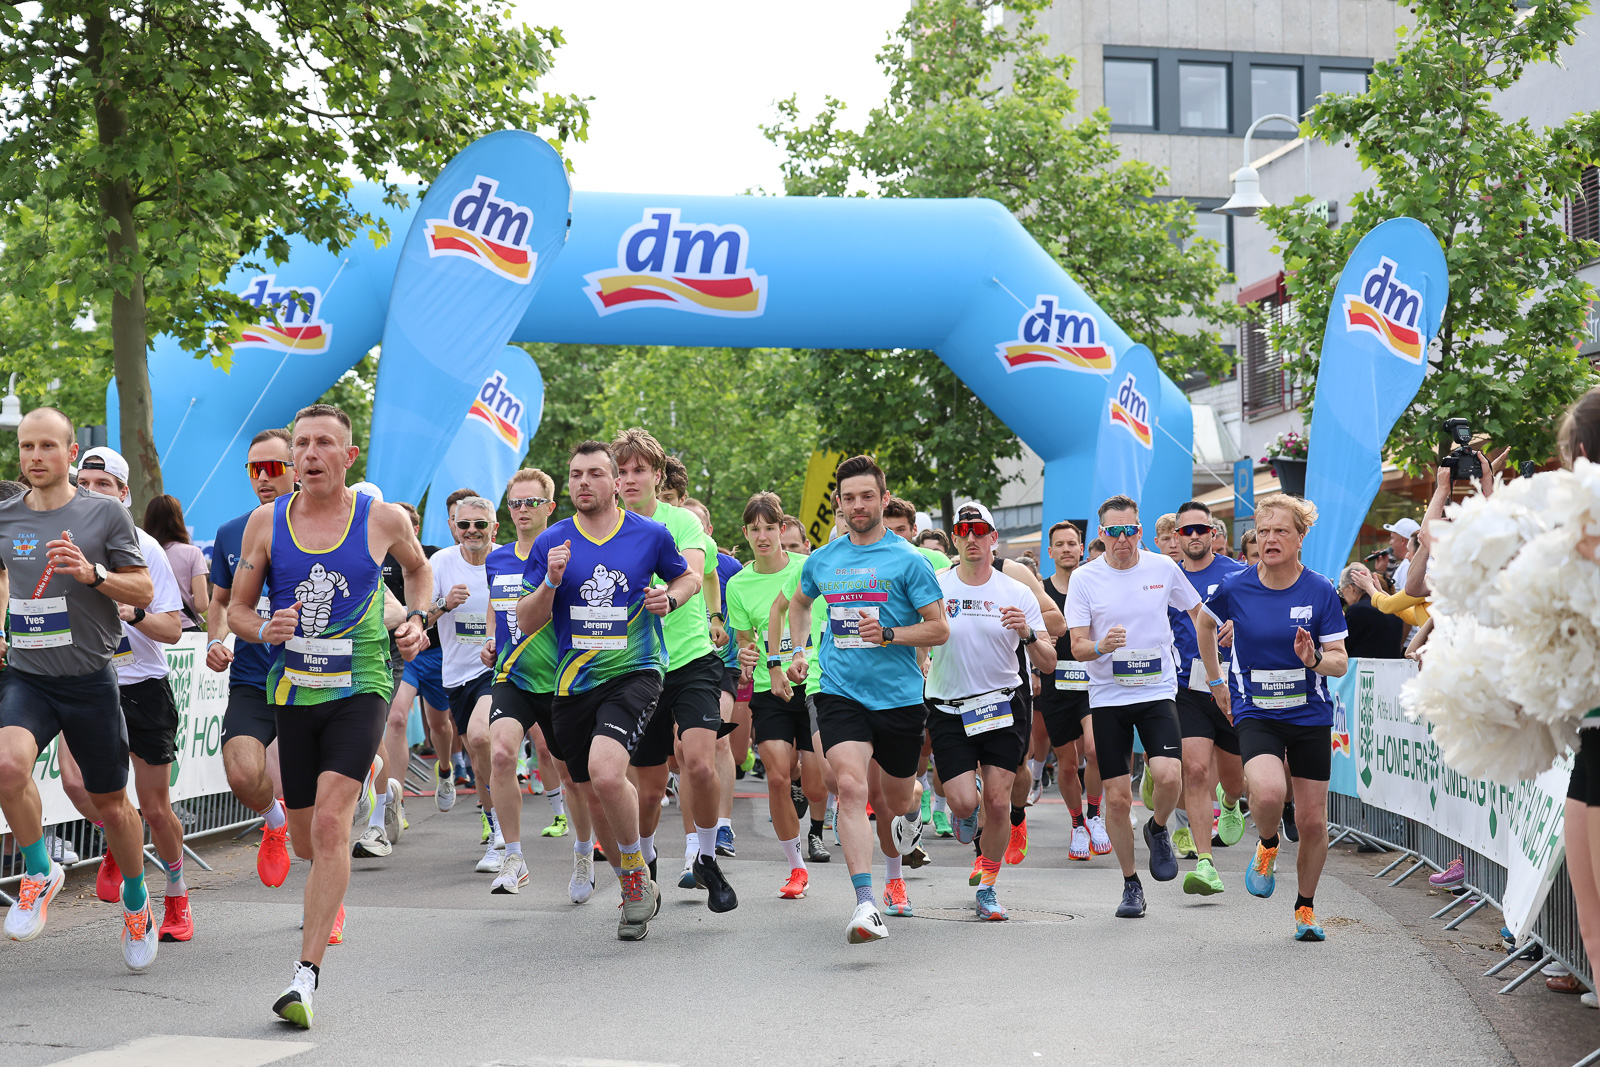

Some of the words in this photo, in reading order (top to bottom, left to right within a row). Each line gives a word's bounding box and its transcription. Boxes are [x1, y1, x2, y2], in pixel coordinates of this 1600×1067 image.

[453, 181, 529, 247] dm
[625, 214, 742, 275] dm
[1364, 264, 1421, 327] dm
[1023, 300, 1096, 344] dm
[481, 376, 523, 418] dm
[1118, 378, 1148, 422] dm
[818, 574, 893, 592] ELEKTROLÜTE
[840, 593, 864, 601] AKTIV
[23, 615, 45, 625] Yves
[582, 620, 613, 631] Jeremy
[303, 653, 329, 666] Marc
[1126, 660, 1151, 669] Stefan
[308, 665, 323, 673] 3253
[1063, 670, 1086, 680] 4650
[1261, 682, 1295, 691] Matthias
[974, 704, 998, 717] Martin
[1377, 734, 1428, 785] HOMBURG
